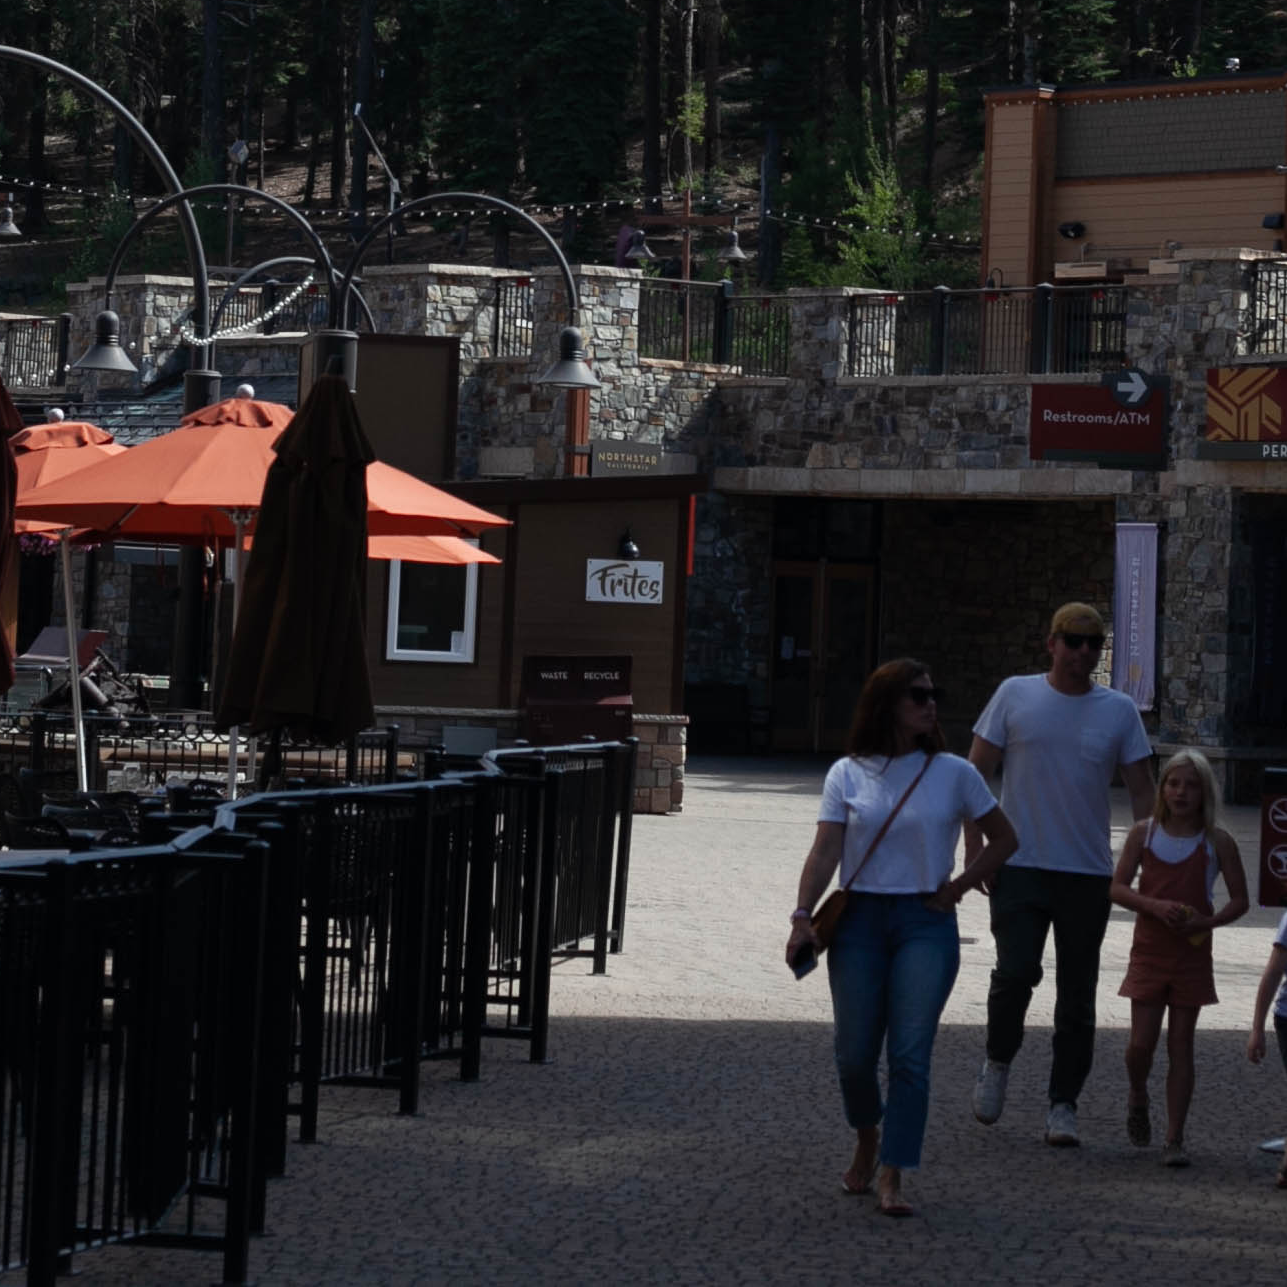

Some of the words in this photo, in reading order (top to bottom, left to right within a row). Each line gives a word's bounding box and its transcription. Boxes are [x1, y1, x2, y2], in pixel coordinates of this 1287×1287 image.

[1042, 409, 1151, 426] Restrooms/ATM
[598, 452, 658, 466] NORTHSTAR
[589, 563, 661, 601] Frites
[1128, 555, 1141, 657] NORTHSTAR
[540, 671, 570, 681] WASTE
[583, 671, 621, 681] RECYCLE
